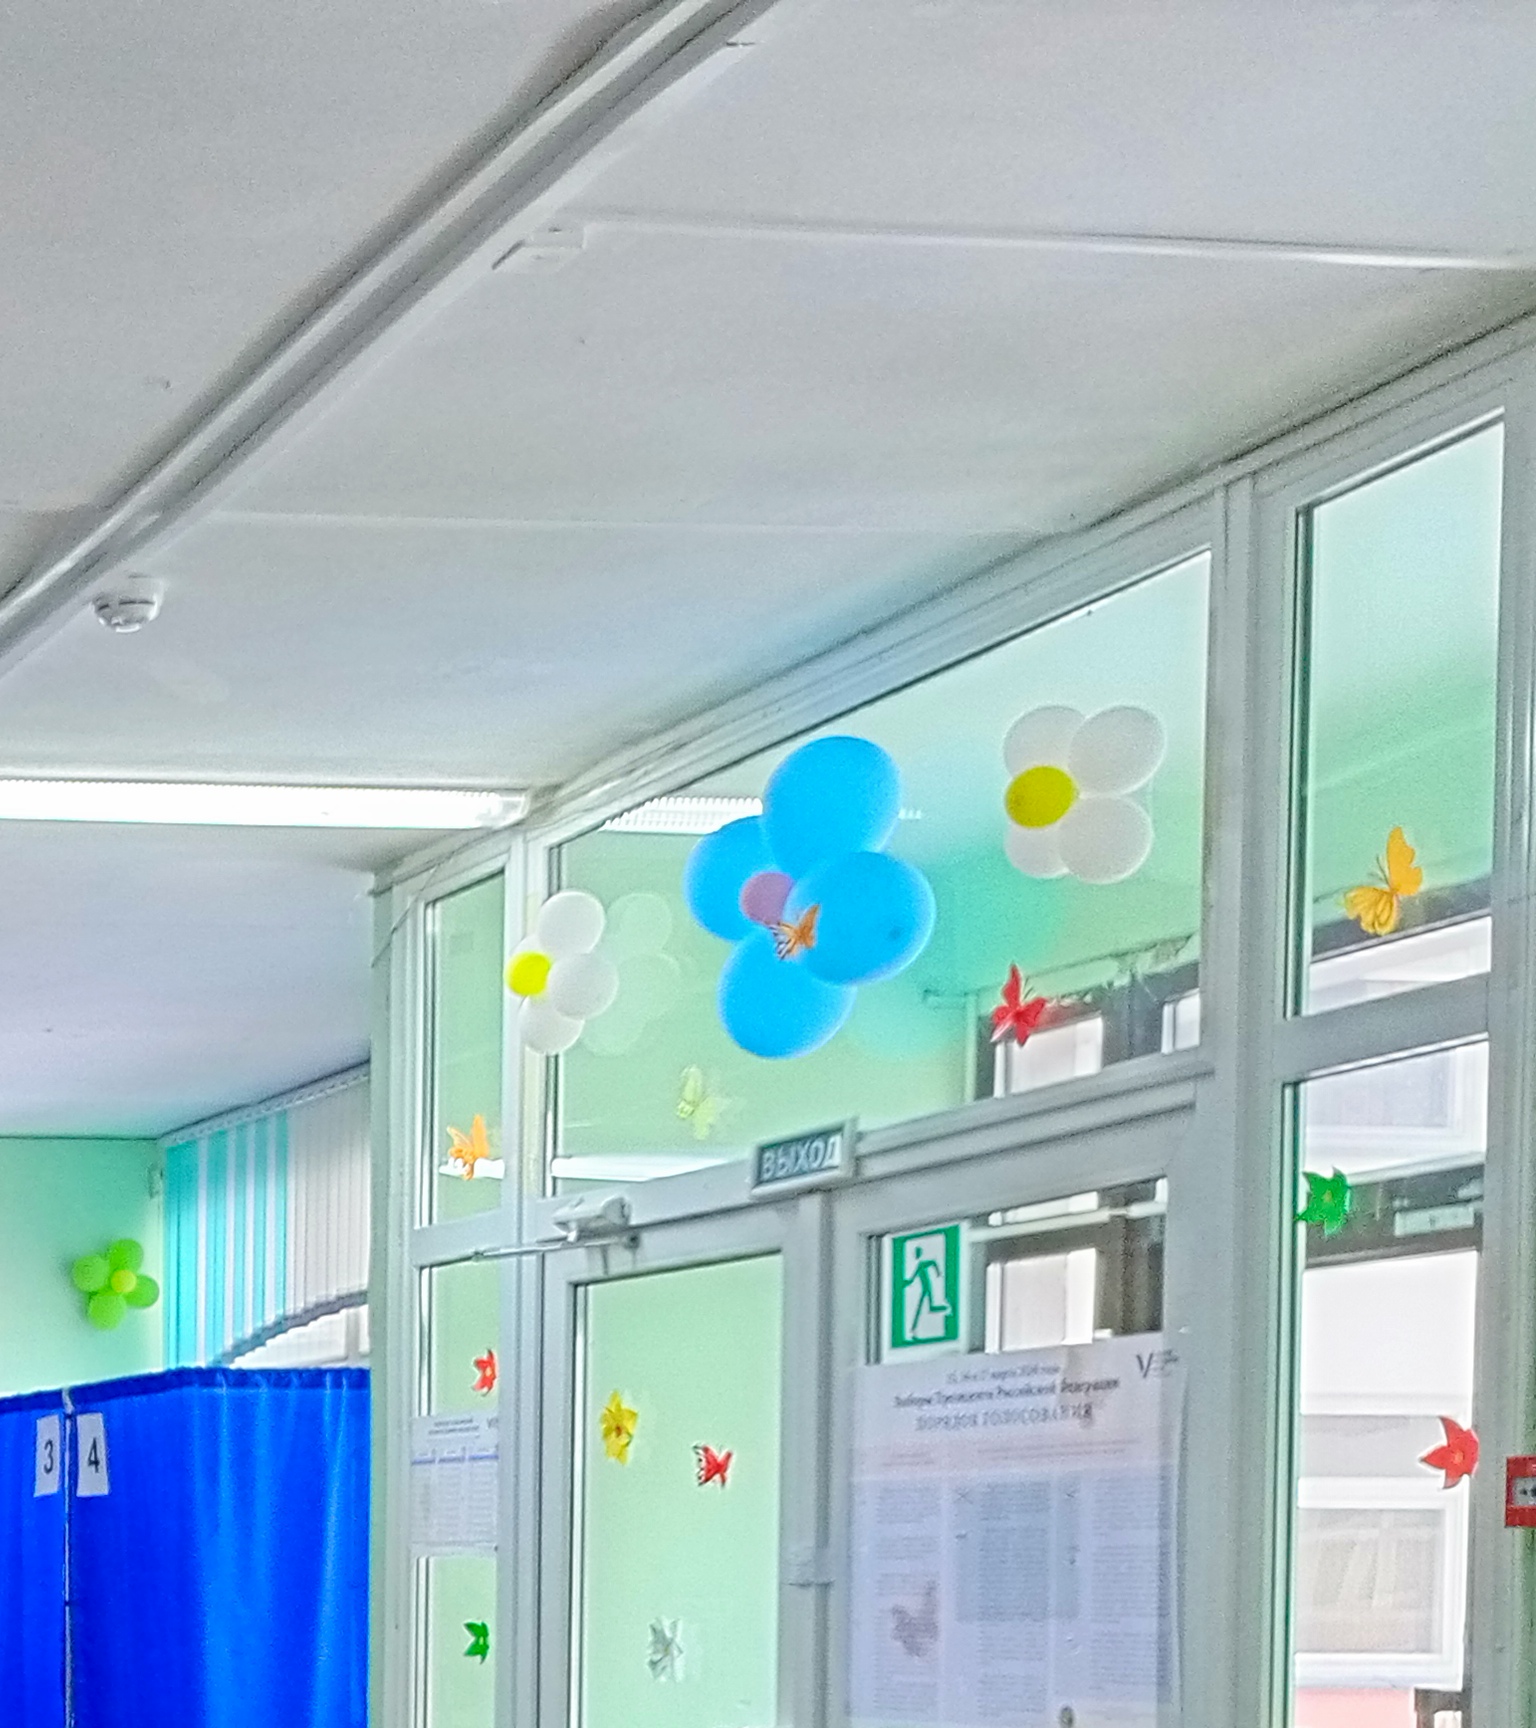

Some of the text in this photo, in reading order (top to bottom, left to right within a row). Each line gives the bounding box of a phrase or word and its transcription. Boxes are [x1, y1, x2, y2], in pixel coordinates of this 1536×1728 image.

[761, 1133, 842, 1181] ВЫХОД
[43, 1439, 54, 1474] 3
[87, 1437, 100, 1473] 4
